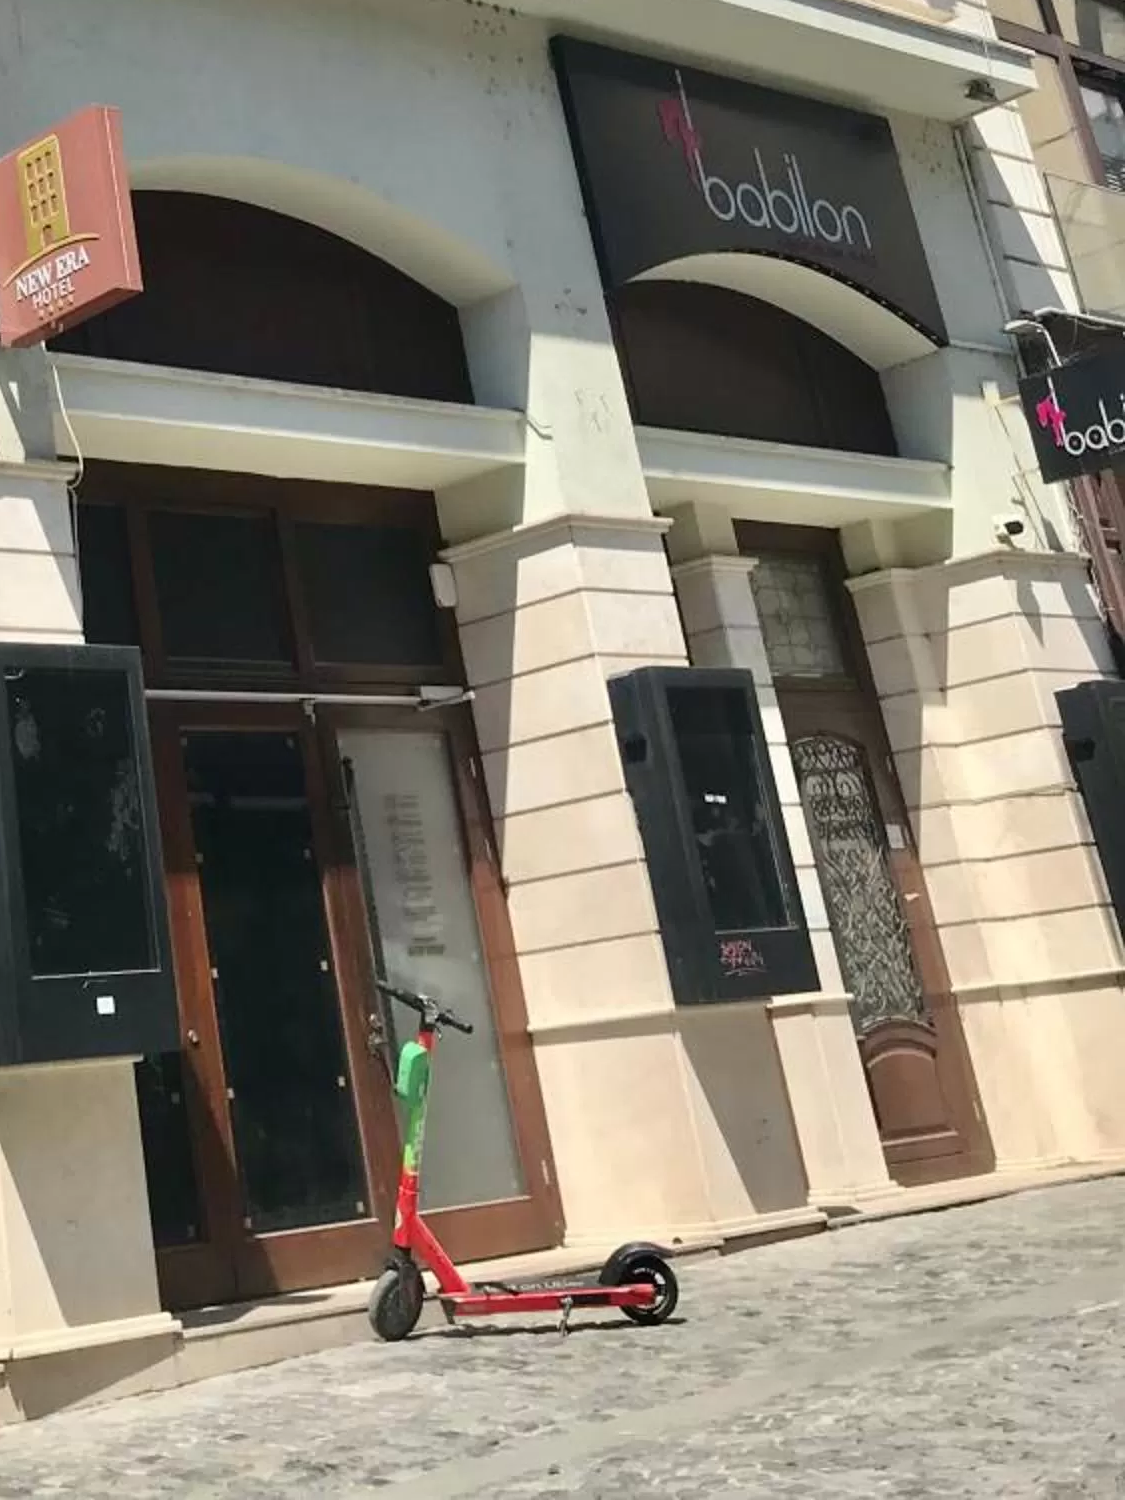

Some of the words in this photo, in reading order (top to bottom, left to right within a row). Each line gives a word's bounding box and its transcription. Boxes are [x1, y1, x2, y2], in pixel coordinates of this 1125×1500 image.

[675, 69, 872, 250] babilon
[15, 261, 52, 302] NEW
[54, 245, 90, 280] ERA
[32, 276, 76, 308] HOTEL
